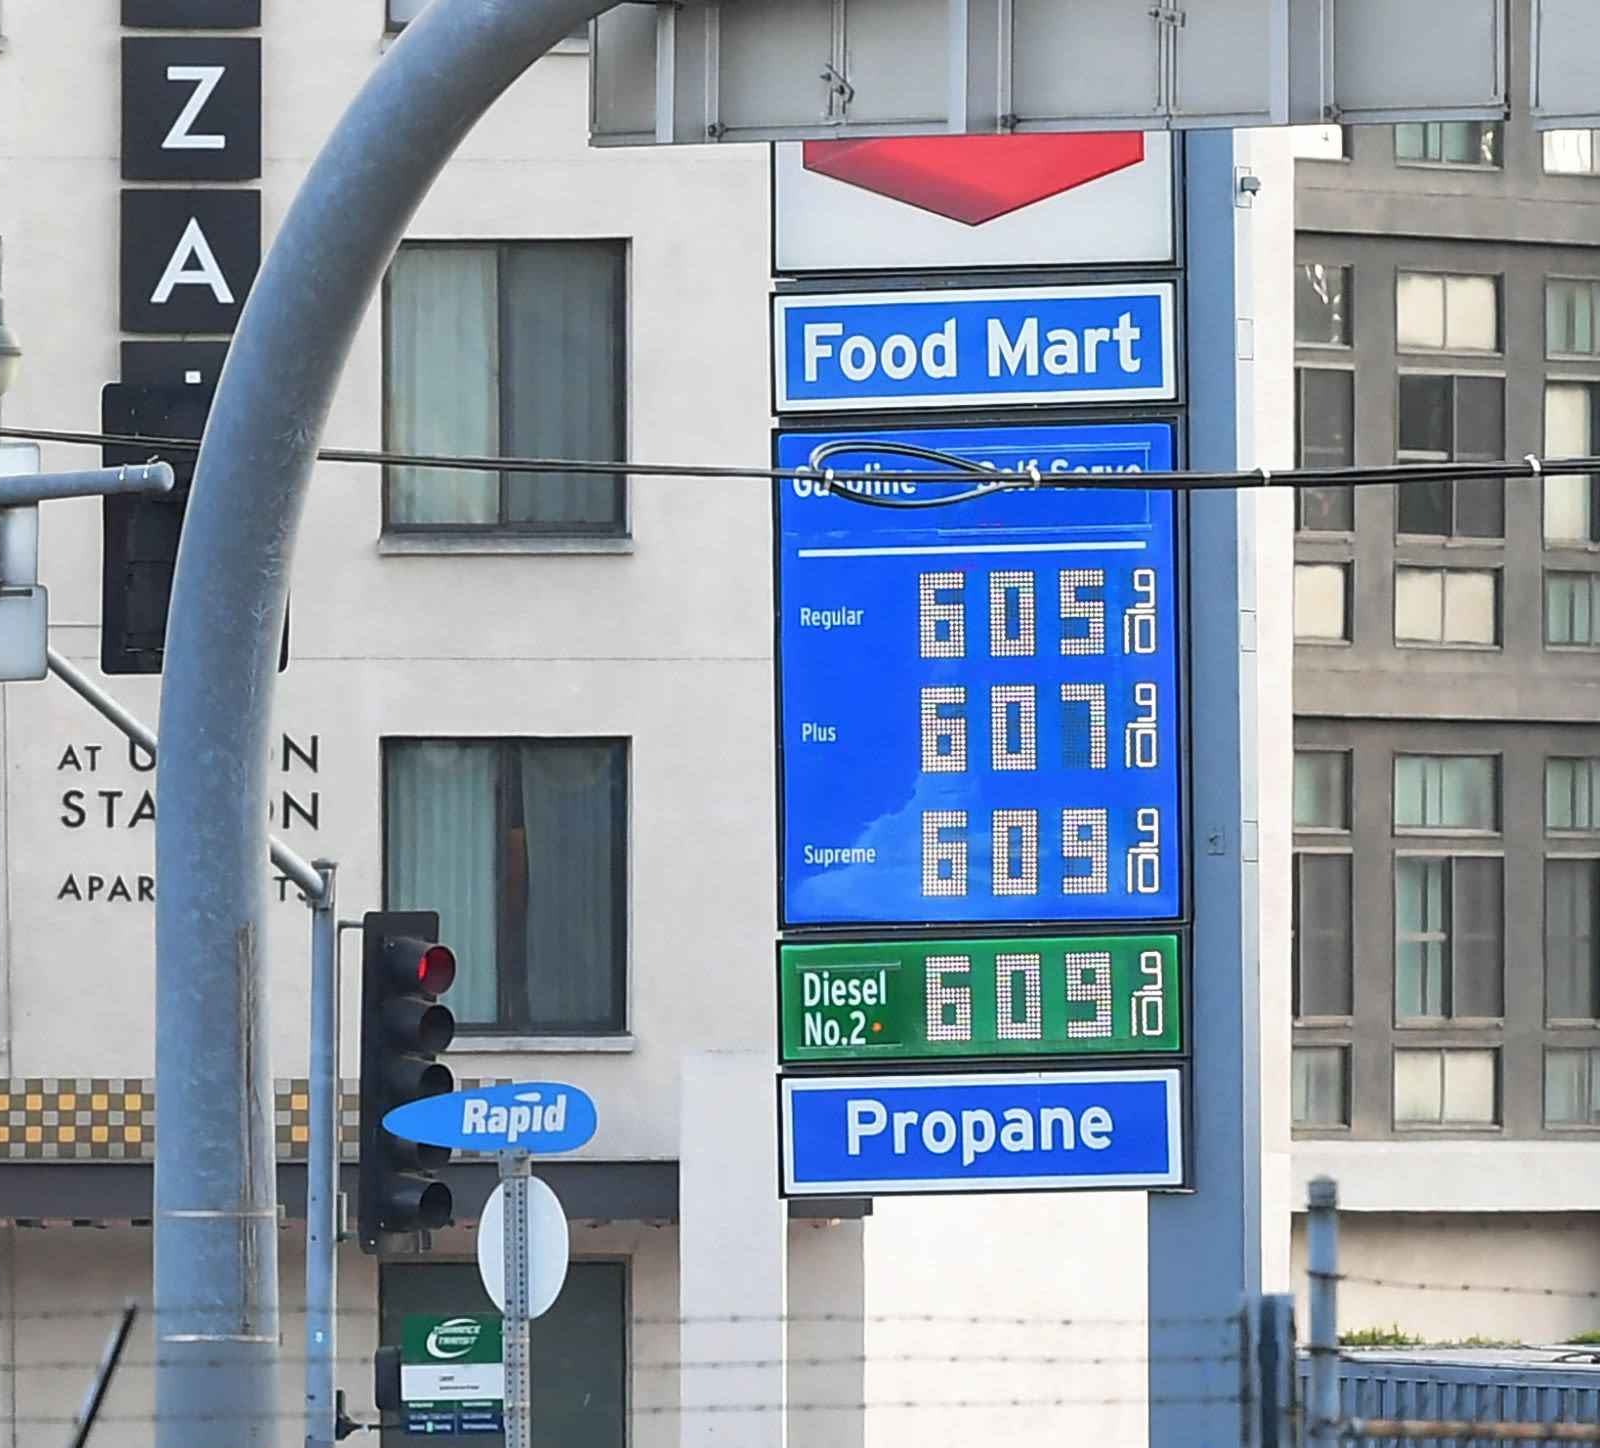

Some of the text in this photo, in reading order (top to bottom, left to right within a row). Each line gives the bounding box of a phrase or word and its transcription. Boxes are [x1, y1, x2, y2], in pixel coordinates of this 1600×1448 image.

[803, 311, 1142, 382] Food Mart
[800, 607, 864, 630] Regular
[919, 569, 1104, 658] 605
[57, 744, 102, 771] AT
[801, 722, 836, 743] Plus
[921, 683, 1106, 773] 607
[61, 789, 319, 830] STAN
[804, 844, 876, 868] Supreme
[922, 808, 1107, 897] 609
[804, 970, 887, 1008] Diesel
[926, 951, 1111, 1041] 609
[804, 1011, 867, 1047] No.2
[462, 1093, 567, 1143] Rapid
[847, 1099, 1113, 1167] Propane
